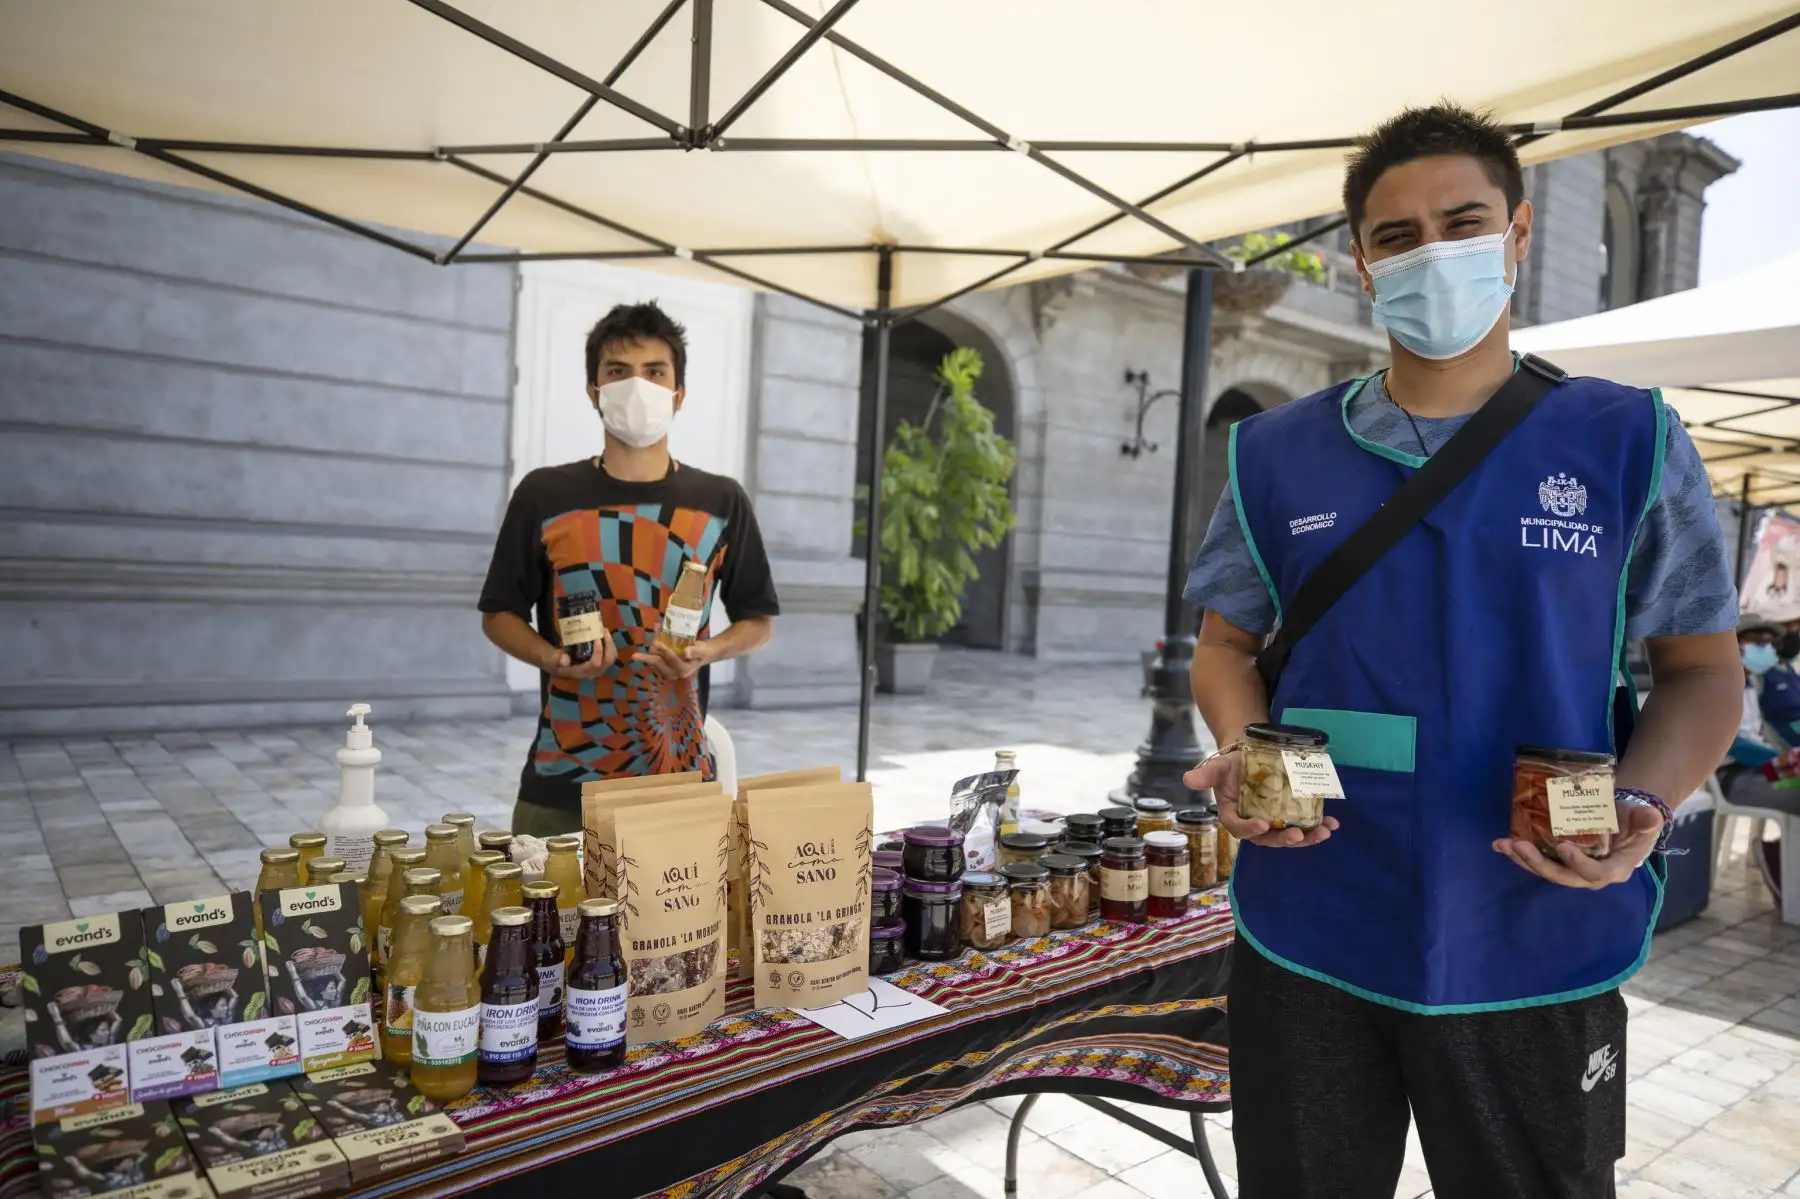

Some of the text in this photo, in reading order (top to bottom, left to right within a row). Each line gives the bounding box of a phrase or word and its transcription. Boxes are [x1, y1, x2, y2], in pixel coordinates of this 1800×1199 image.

[1289, 511, 1337, 528] DESARROLLO
[1520, 517, 1604, 534] MUNICIPALIDAD DE
[1521, 526, 1598, 558] LIMA
[1562, 788, 1600, 798] MUSKHIY
[796, 868, 836, 884] SANO
[289, 896, 336, 911] evand's
[664, 894, 699, 912] SANO
[175, 907, 228, 927] evand's
[766, 912, 812, 924] GRANOLA
[55, 926, 113, 947] evand's
[632, 936, 677, 950] GRANOLA
[575, 993, 622, 1005] IRON DRINK
[486, 1008, 513, 1018] IRON
[433, 1021, 450, 1032] CON
[586, 1024, 614, 1033] evand's
[499, 1036, 530, 1048] evand's
[1588, 1044, 1611, 1076] NIKE
[1604, 1063, 1617, 1083] SB
